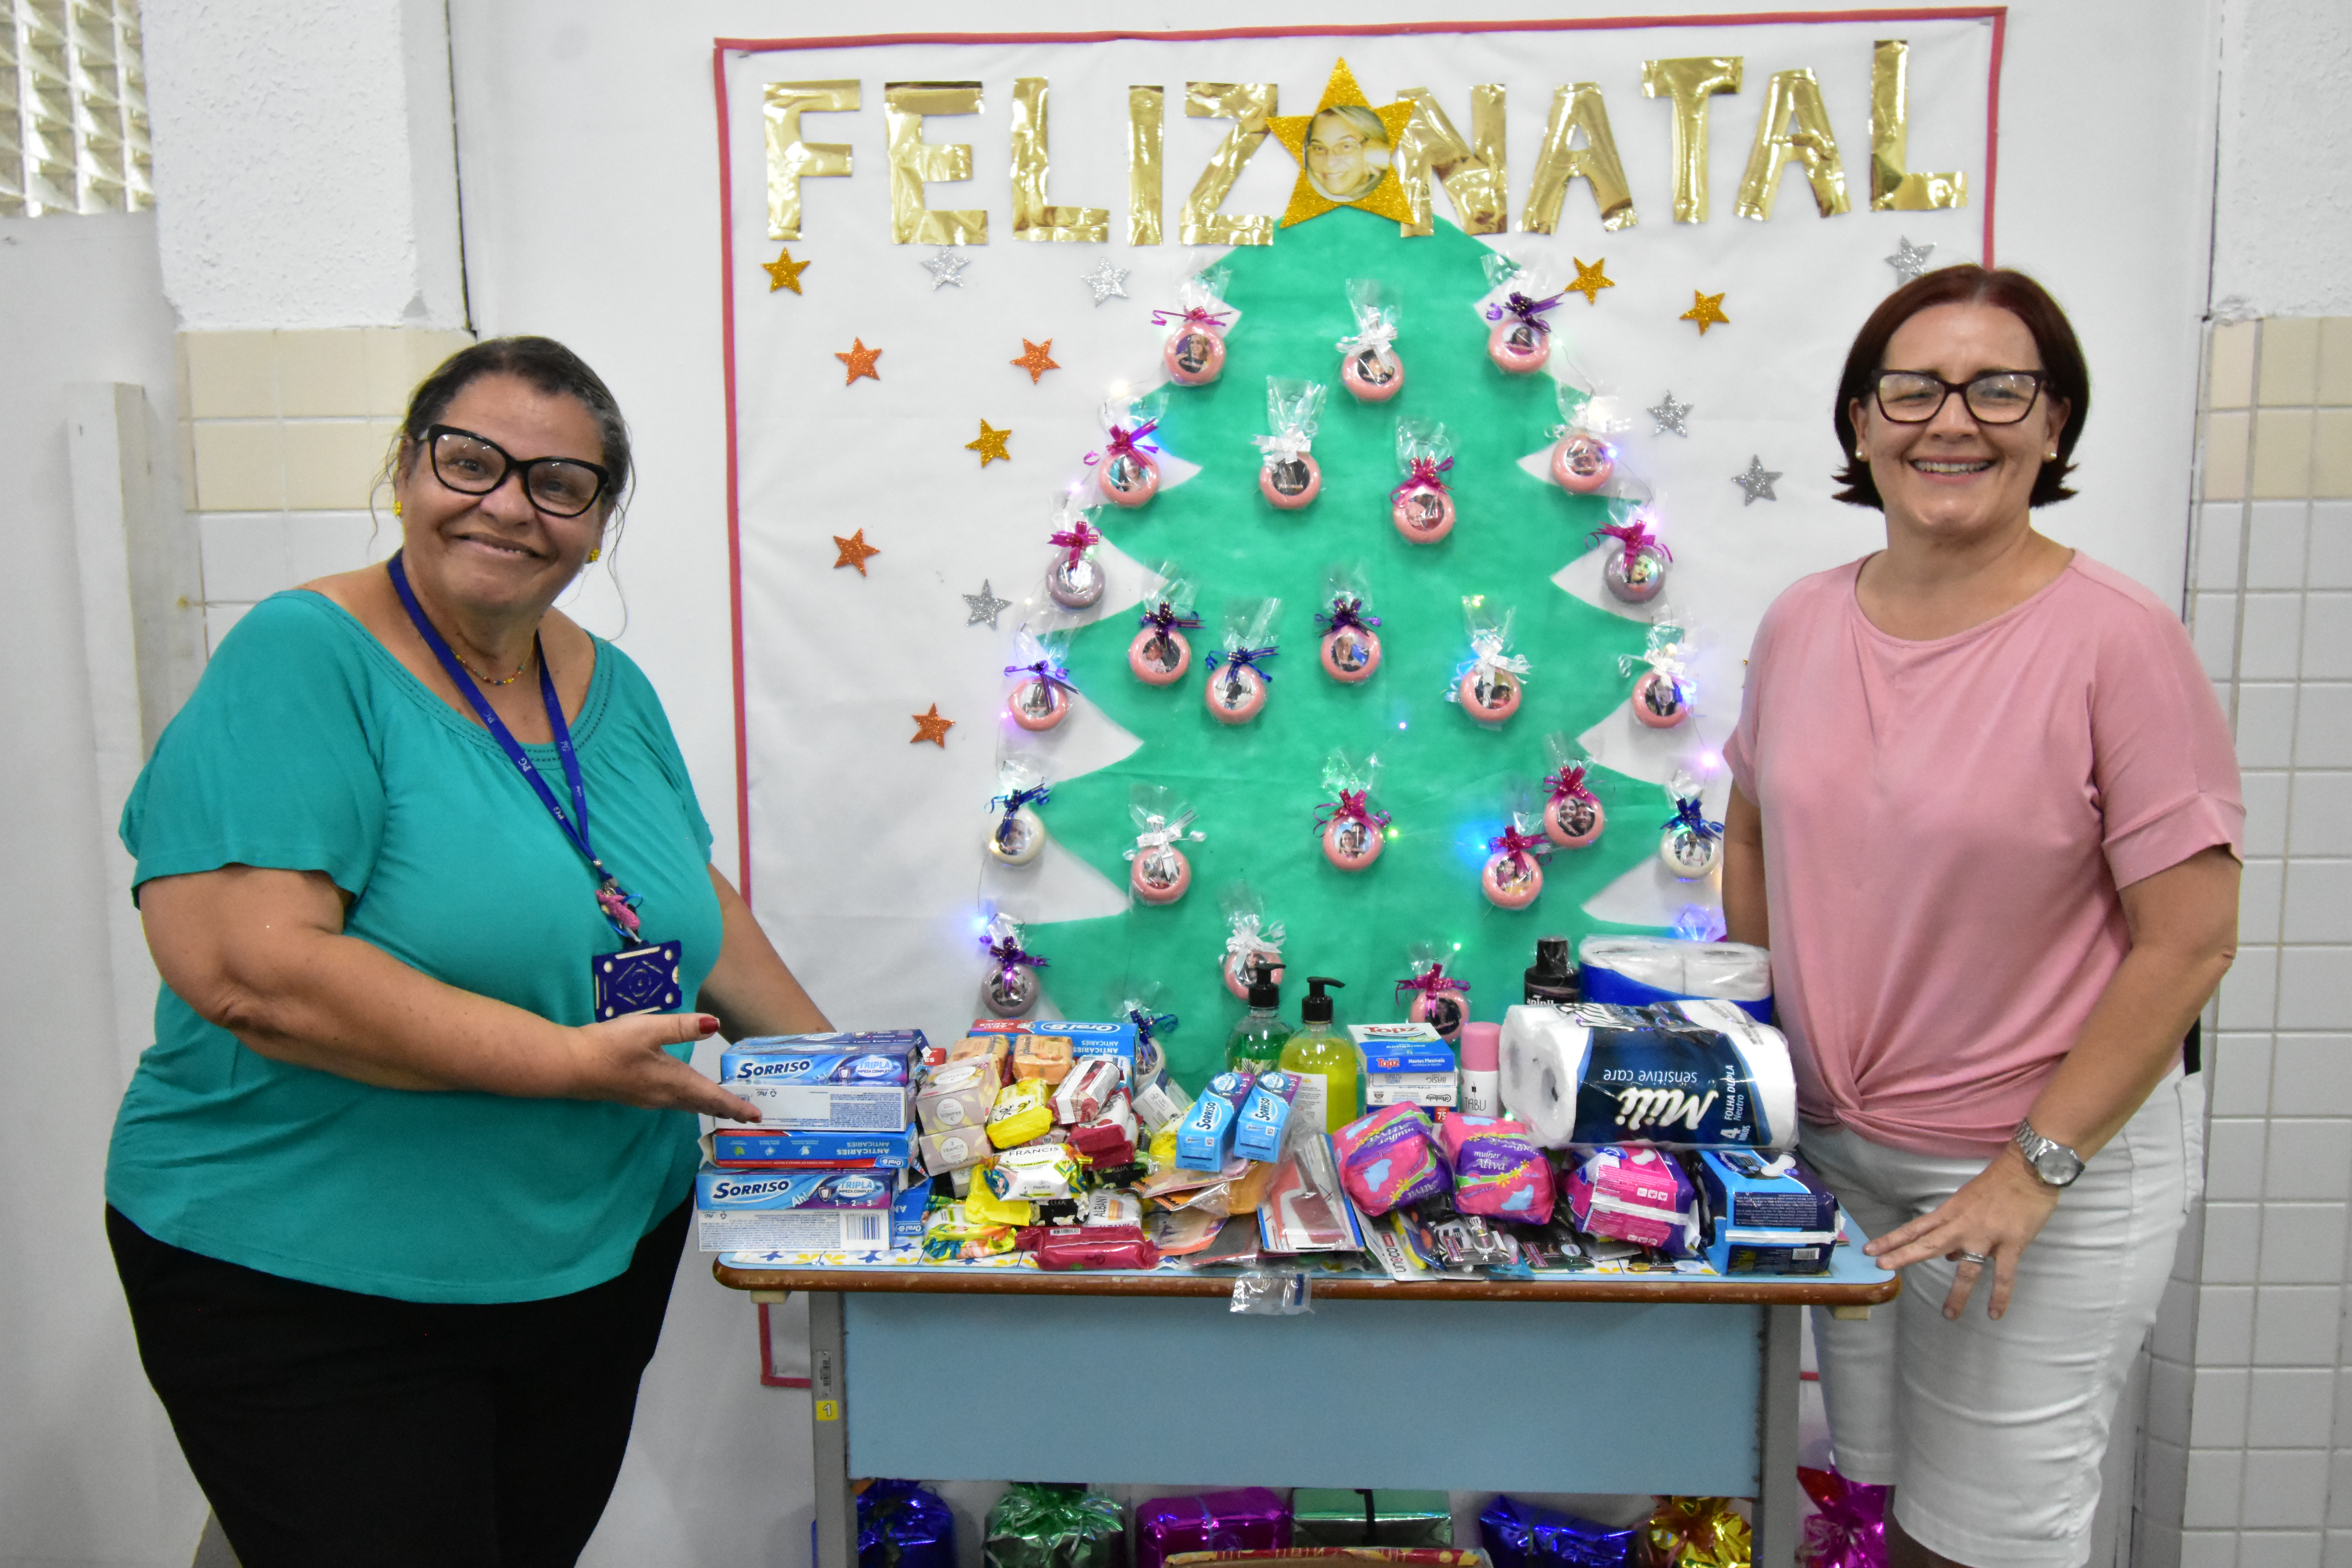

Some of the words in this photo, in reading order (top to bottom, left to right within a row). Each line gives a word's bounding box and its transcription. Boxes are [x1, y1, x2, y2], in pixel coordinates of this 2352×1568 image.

[763, 76, 1279, 247] FELIZ
[1398, 40, 1968, 238] NATAL
[518, 757, 532, 772] PG
[737, 1061, 810, 1078] SORRISO
[1377, 1058, 1400, 1069] Topz
[1604, 1069, 1633, 1081] care
[1639, 1071, 1697, 1085] sensitive
[1725, 1065, 1736, 1093] DUPLA
[1426, 1094, 1452, 1102] Cottonbaby
[1465, 1097, 1486, 1111] TABU
[1255, 1098, 1270, 1121] SORRISO
[1615, 1087, 1719, 1131] Mili
[1724, 1095, 1735, 1120] FOLHA
[1733, 1094, 1744, 1121] Neutro
[1196, 1102, 1216, 1130] SORRISO
[1437, 1112, 1446, 1120] 75
[1720, 1127, 1741, 1139] 4
[943, 1144, 964, 1153] FRANCIS
[1009, 1147, 1058, 1156] FRANCIS
[1474, 1150, 1501, 1159] mulher
[1473, 1158, 1505, 1171] Ativa
[713, 1180, 789, 1199] SORRISO
[792, 1192, 809, 1208] Ah!
[1093, 1196, 1108, 1217] ALBANY
[823, 1403, 831, 1417] 1
